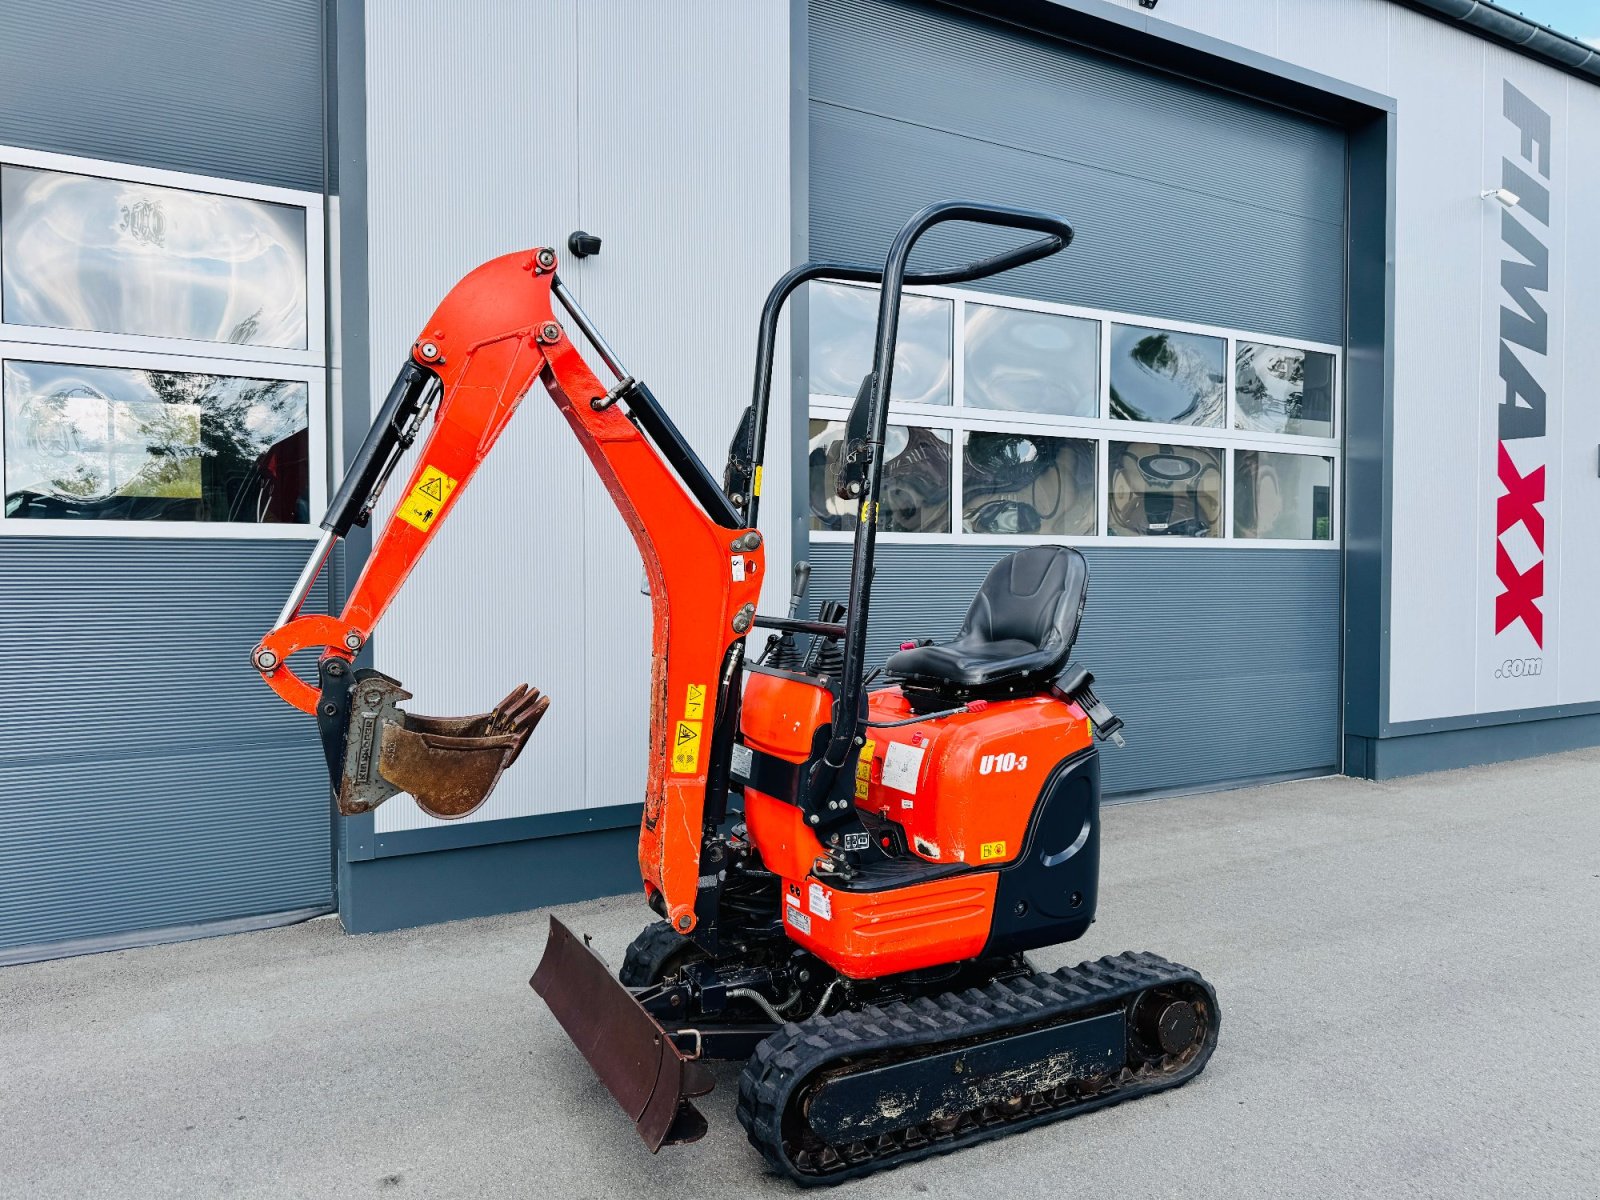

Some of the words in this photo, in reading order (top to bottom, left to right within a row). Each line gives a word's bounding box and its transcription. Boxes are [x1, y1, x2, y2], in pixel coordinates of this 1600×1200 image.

[1495, 77, 1551, 650] FIMAXX
[1495, 657, 1542, 678] .com
[979, 752, 1028, 776] U10-3
